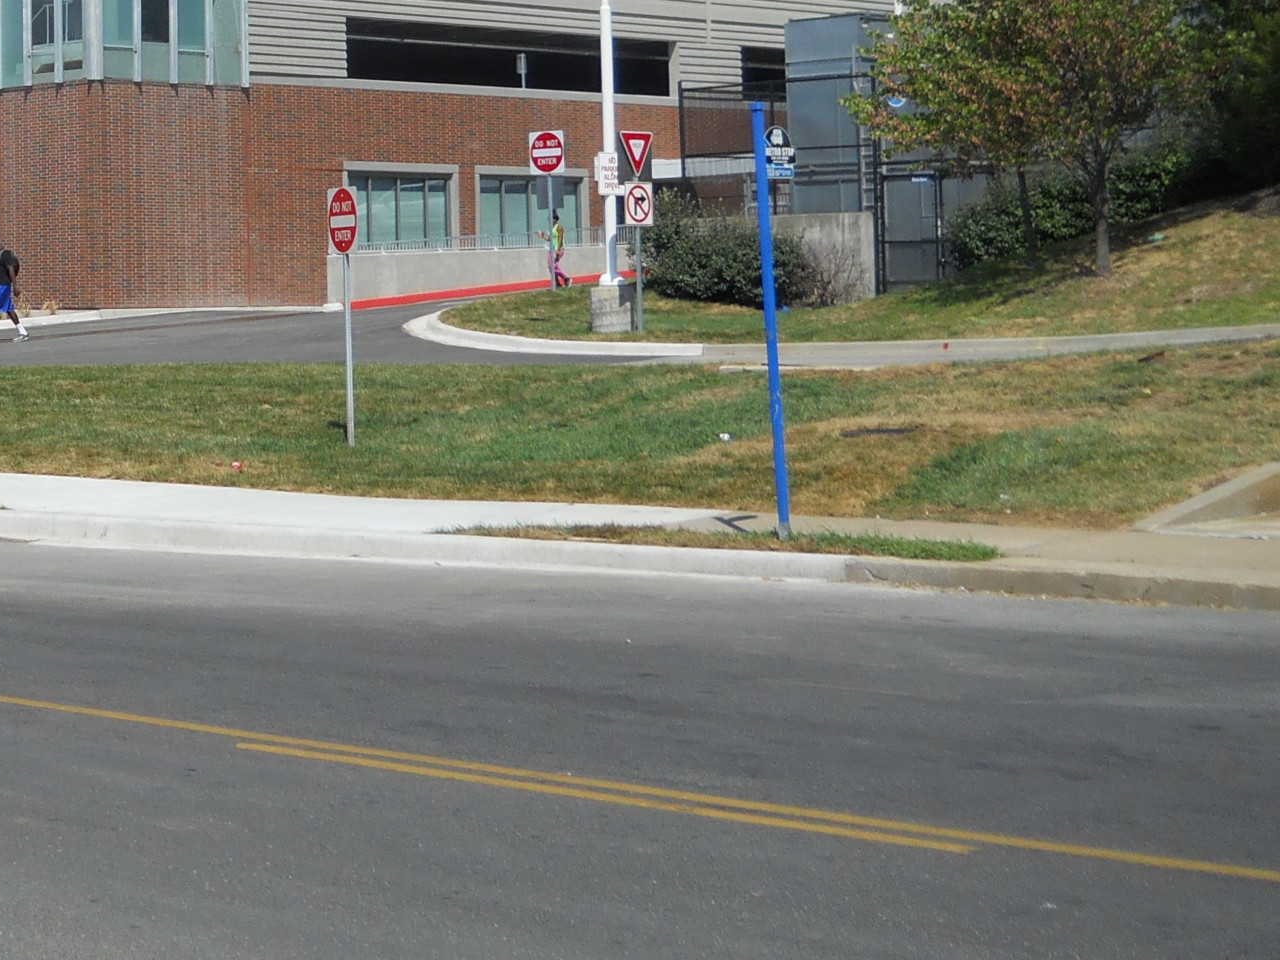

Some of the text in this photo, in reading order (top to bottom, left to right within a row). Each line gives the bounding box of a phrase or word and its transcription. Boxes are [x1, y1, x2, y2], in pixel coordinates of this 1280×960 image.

[534, 139, 558, 148] DO NOT
[537, 157, 557, 166] ENTER
[332, 200, 352, 213] DO NOT
[334, 230, 352, 241] ENTER
